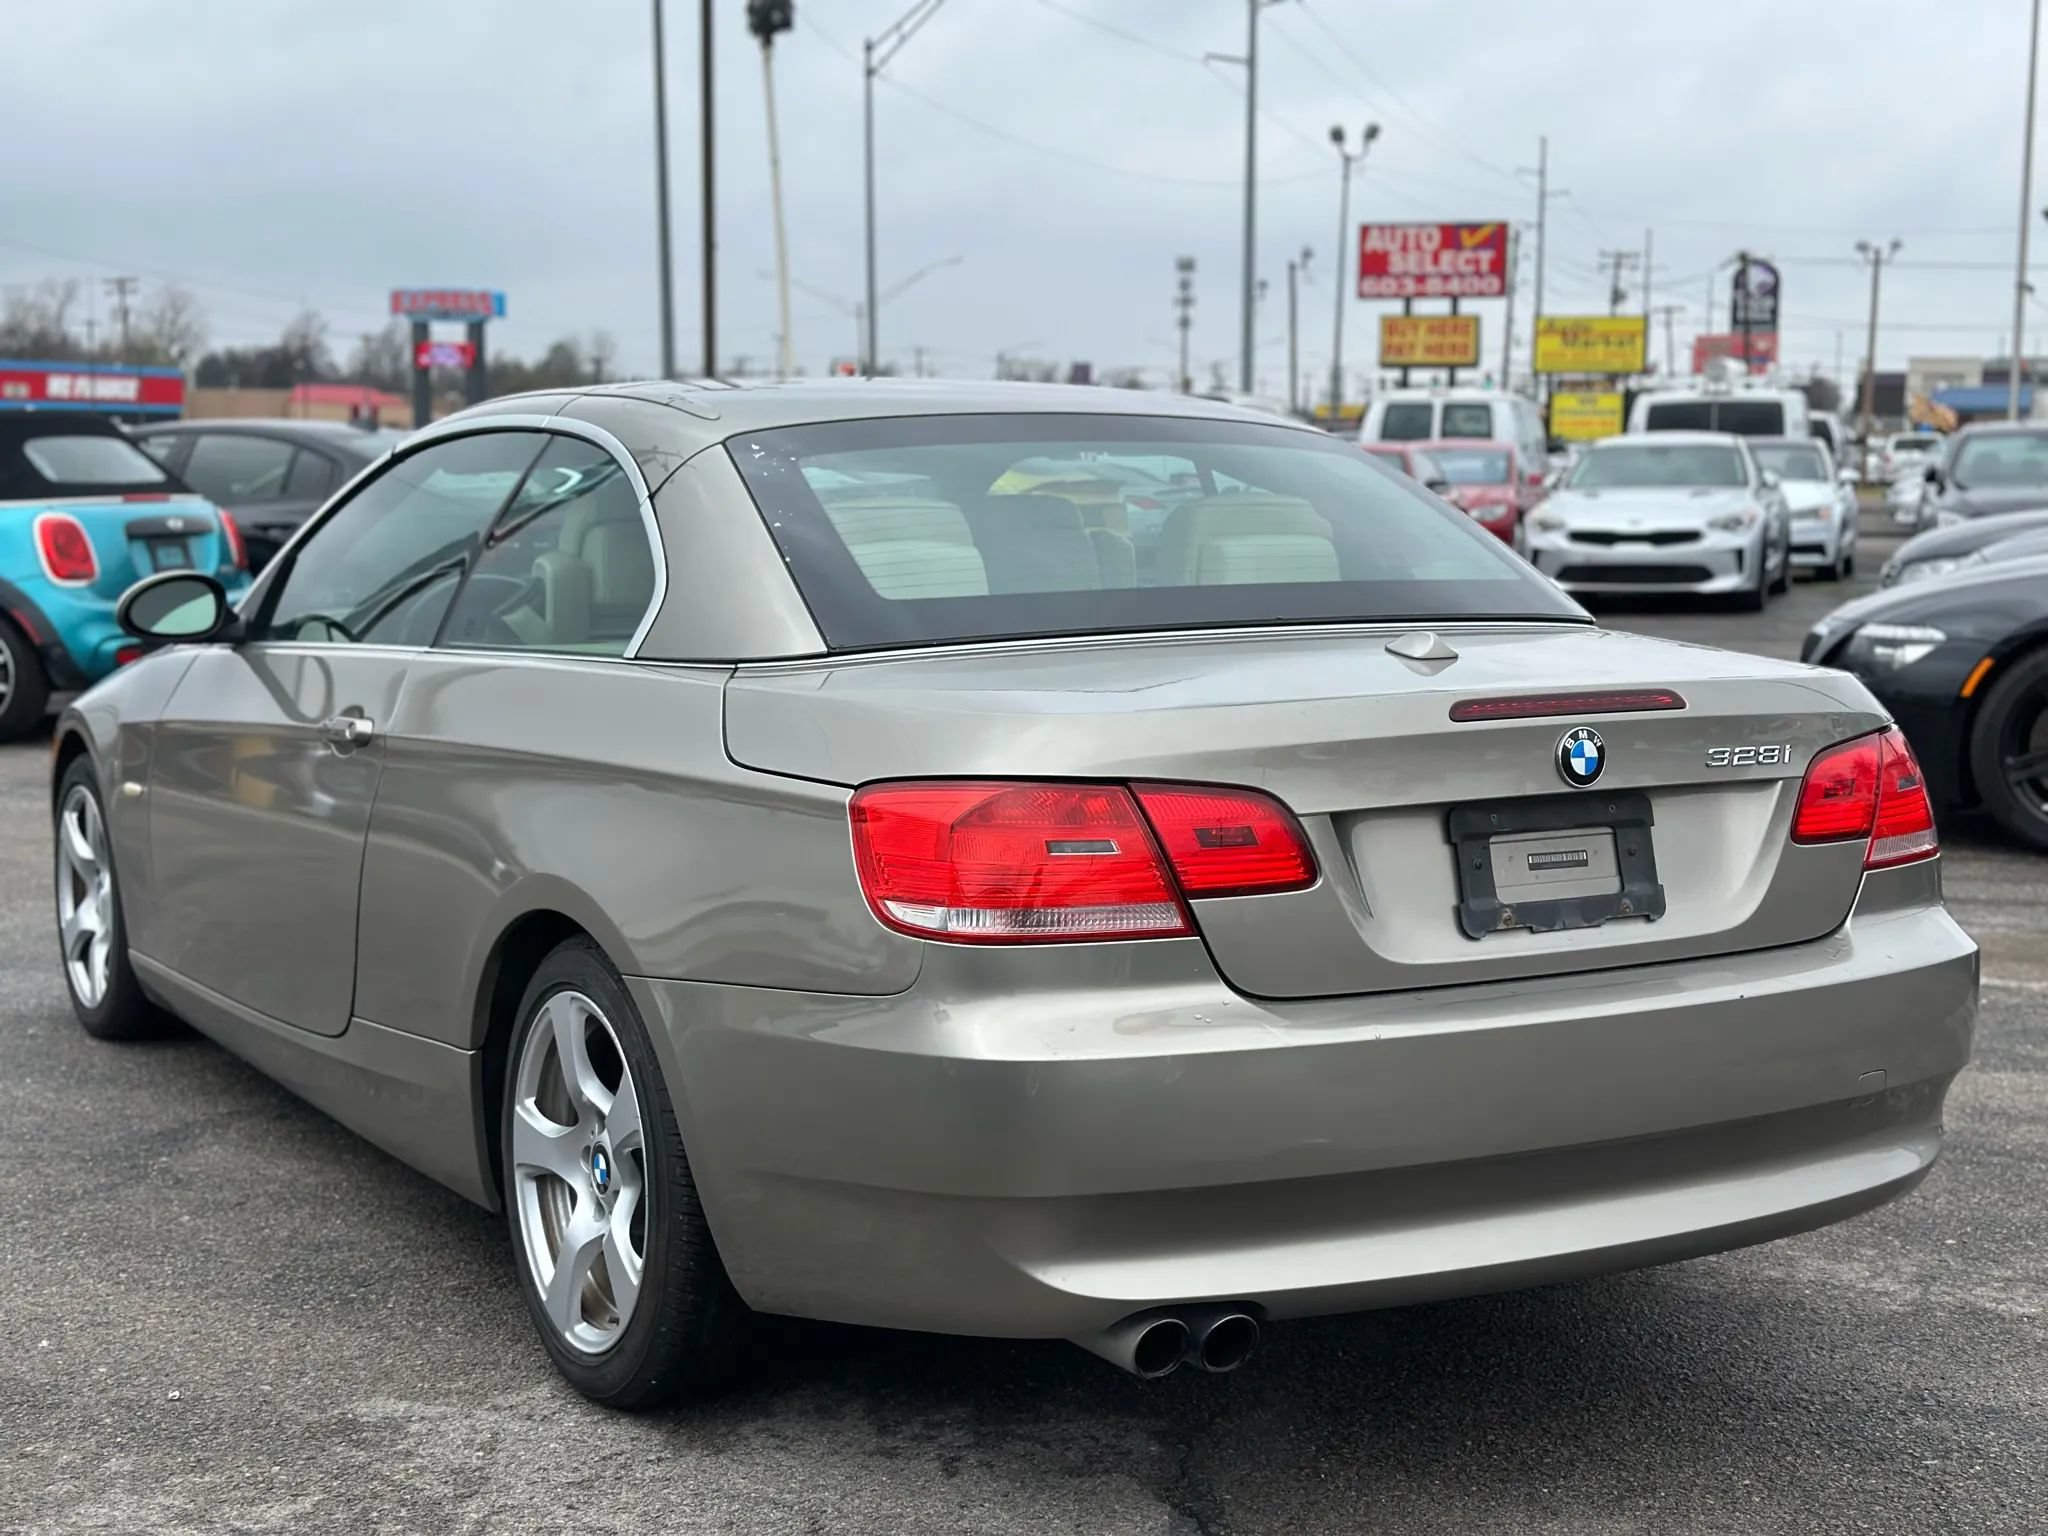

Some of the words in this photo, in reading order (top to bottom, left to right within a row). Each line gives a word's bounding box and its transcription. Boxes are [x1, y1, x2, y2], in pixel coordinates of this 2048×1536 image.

[1364, 227, 1441, 253] AUTO
[1386, 250, 1496, 274] SELECT
[1361, 275, 1502, 296] 603-8400
[1384, 319, 1418, 337] BUY
[1424, 319, 1473, 336] HERE
[1384, 340, 1417, 357] PAY
[1423, 340, 1470, 356] HERE
[1565, 730, 1602, 749] BMW
[1705, 744, 1792, 767] 328i
